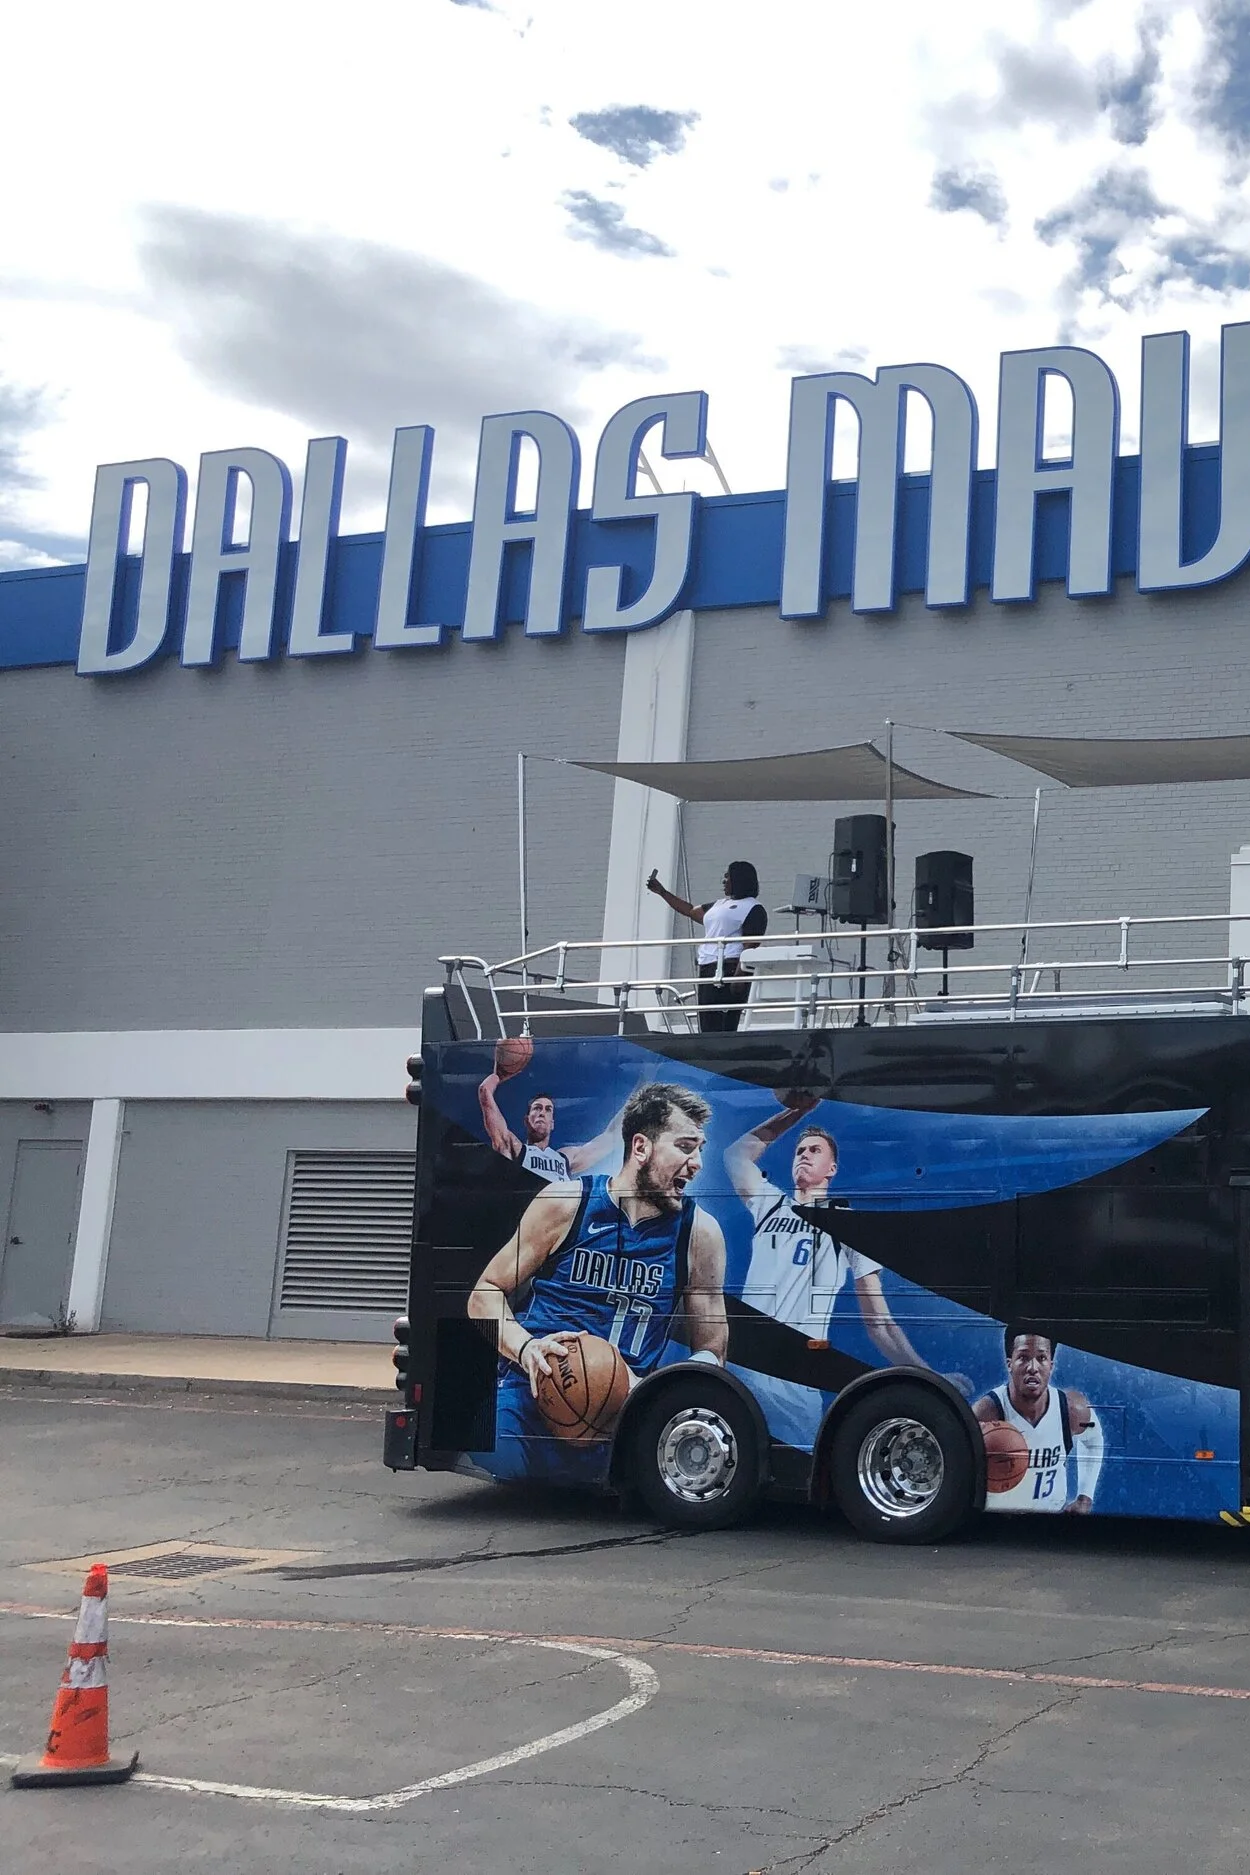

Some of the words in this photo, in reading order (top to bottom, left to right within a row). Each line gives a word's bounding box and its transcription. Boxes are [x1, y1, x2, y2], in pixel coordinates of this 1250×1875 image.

[75, 390, 709, 677] DALLAS
[529, 1156, 566, 1177] DALLAS
[569, 1248, 665, 1299] DALLAS
[606, 1291, 654, 1358] 77
[1031, 1469, 1058, 1500] 13
